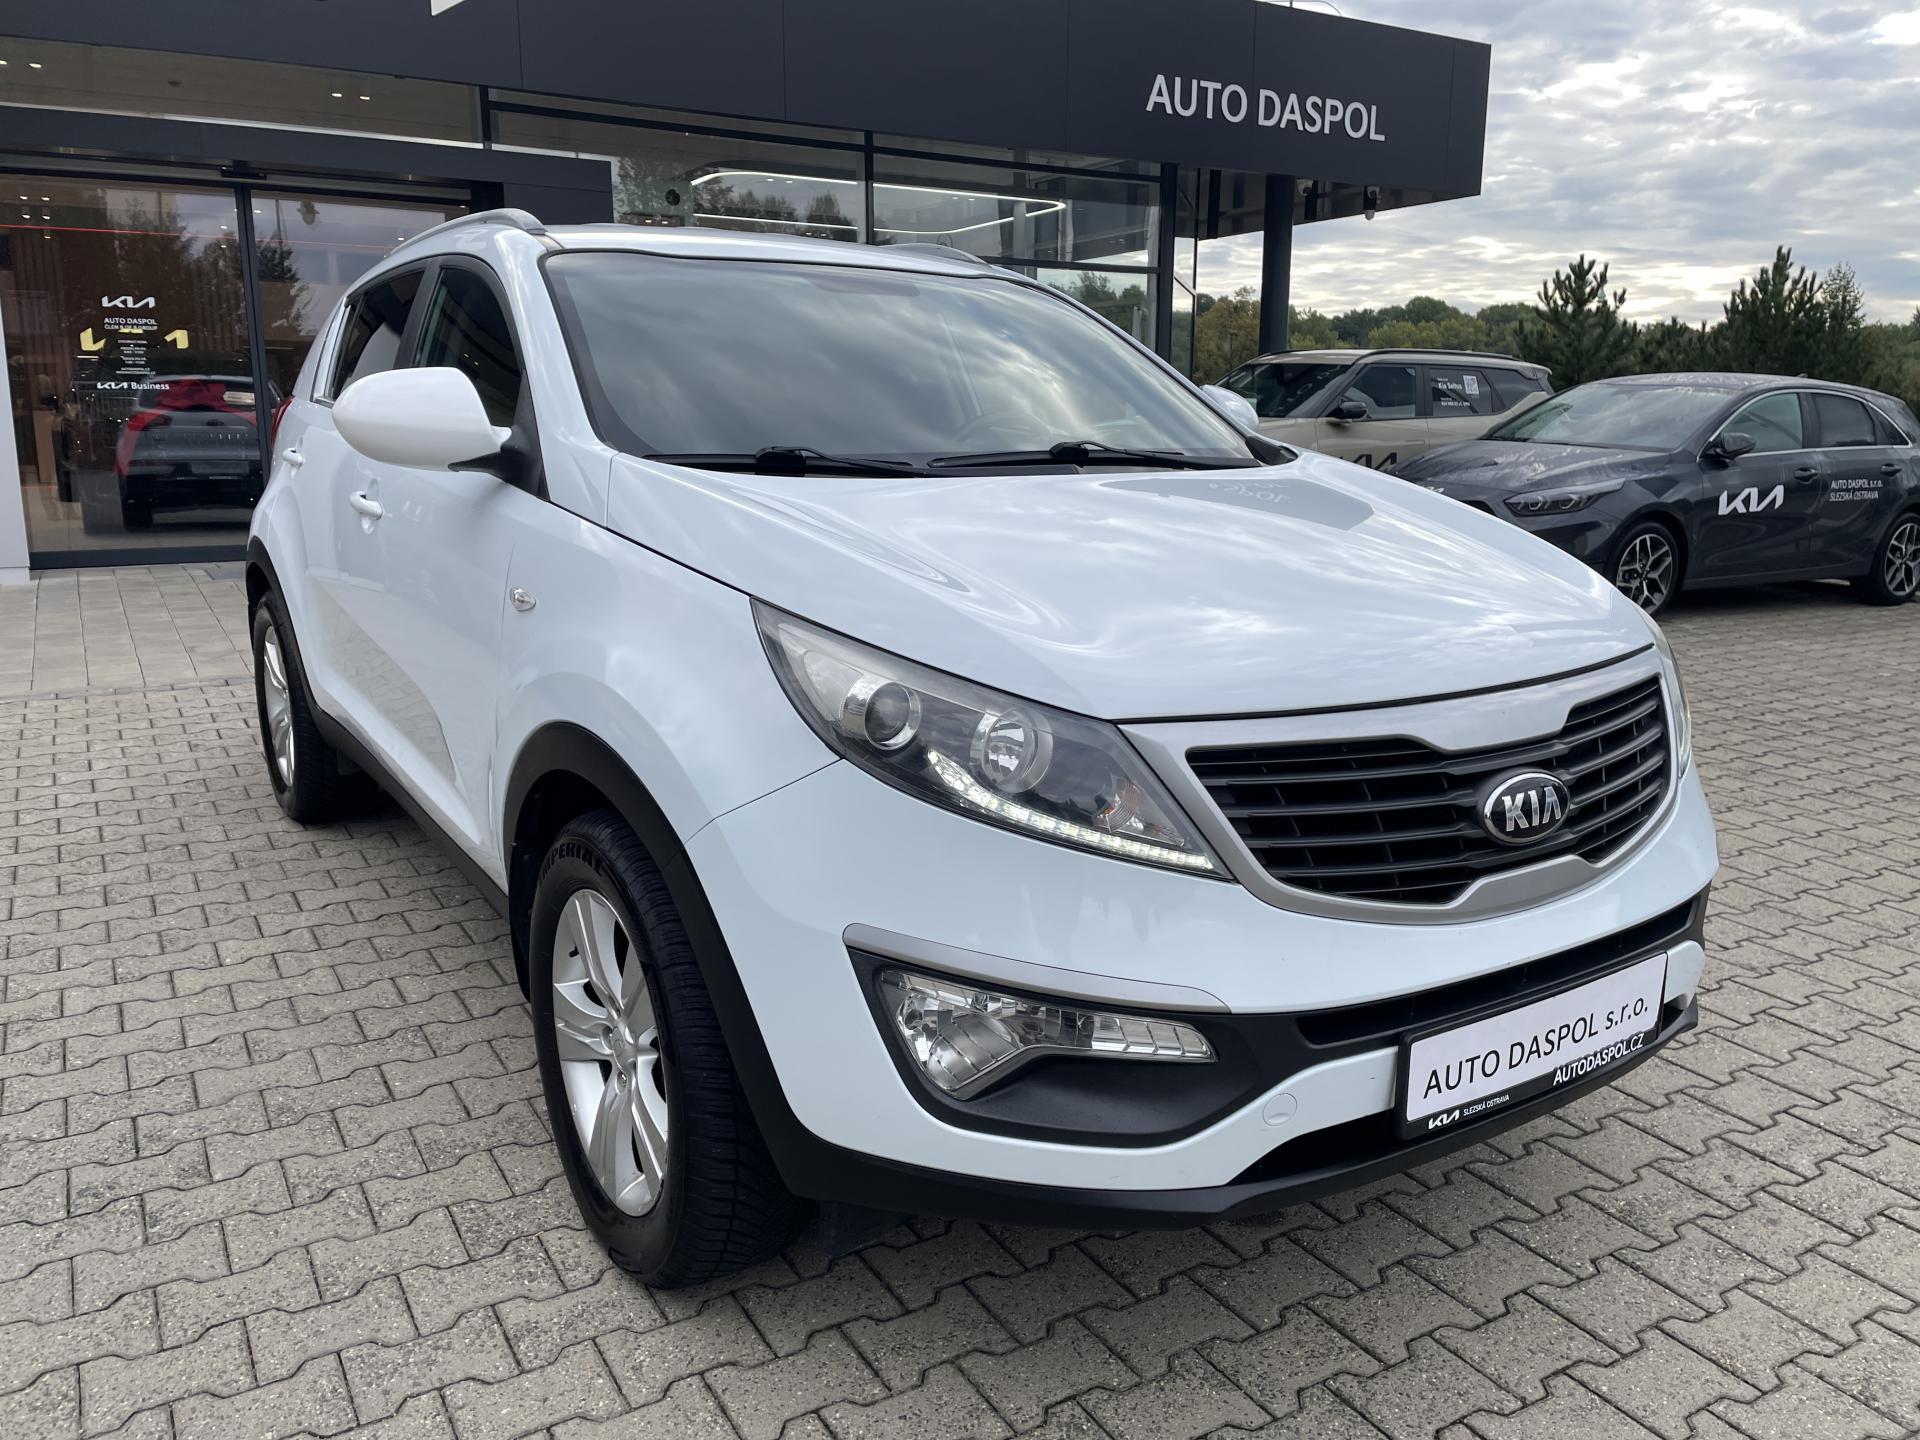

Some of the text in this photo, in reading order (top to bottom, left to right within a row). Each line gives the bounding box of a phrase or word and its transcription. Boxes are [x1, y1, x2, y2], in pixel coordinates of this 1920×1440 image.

[1145, 73, 1387, 142] AUTO DASPOL
[131, 382, 170, 390] Business
[1829, 490, 1879, 501] SLEZSKÁ OSTRAVA
[1831, 479, 1883, 489] AUTO DASPOL s.r.o.
[1501, 786, 1562, 832] KIA
[1423, 996, 1649, 1099] AUTO DASPOL s.r.o.
[1552, 1033, 1645, 1086] AUTODASPOL.CZ
[1463, 1101, 1486, 1116] SLEZSKÁ
[1486, 1094, 1510, 1108] OSTRAVA
